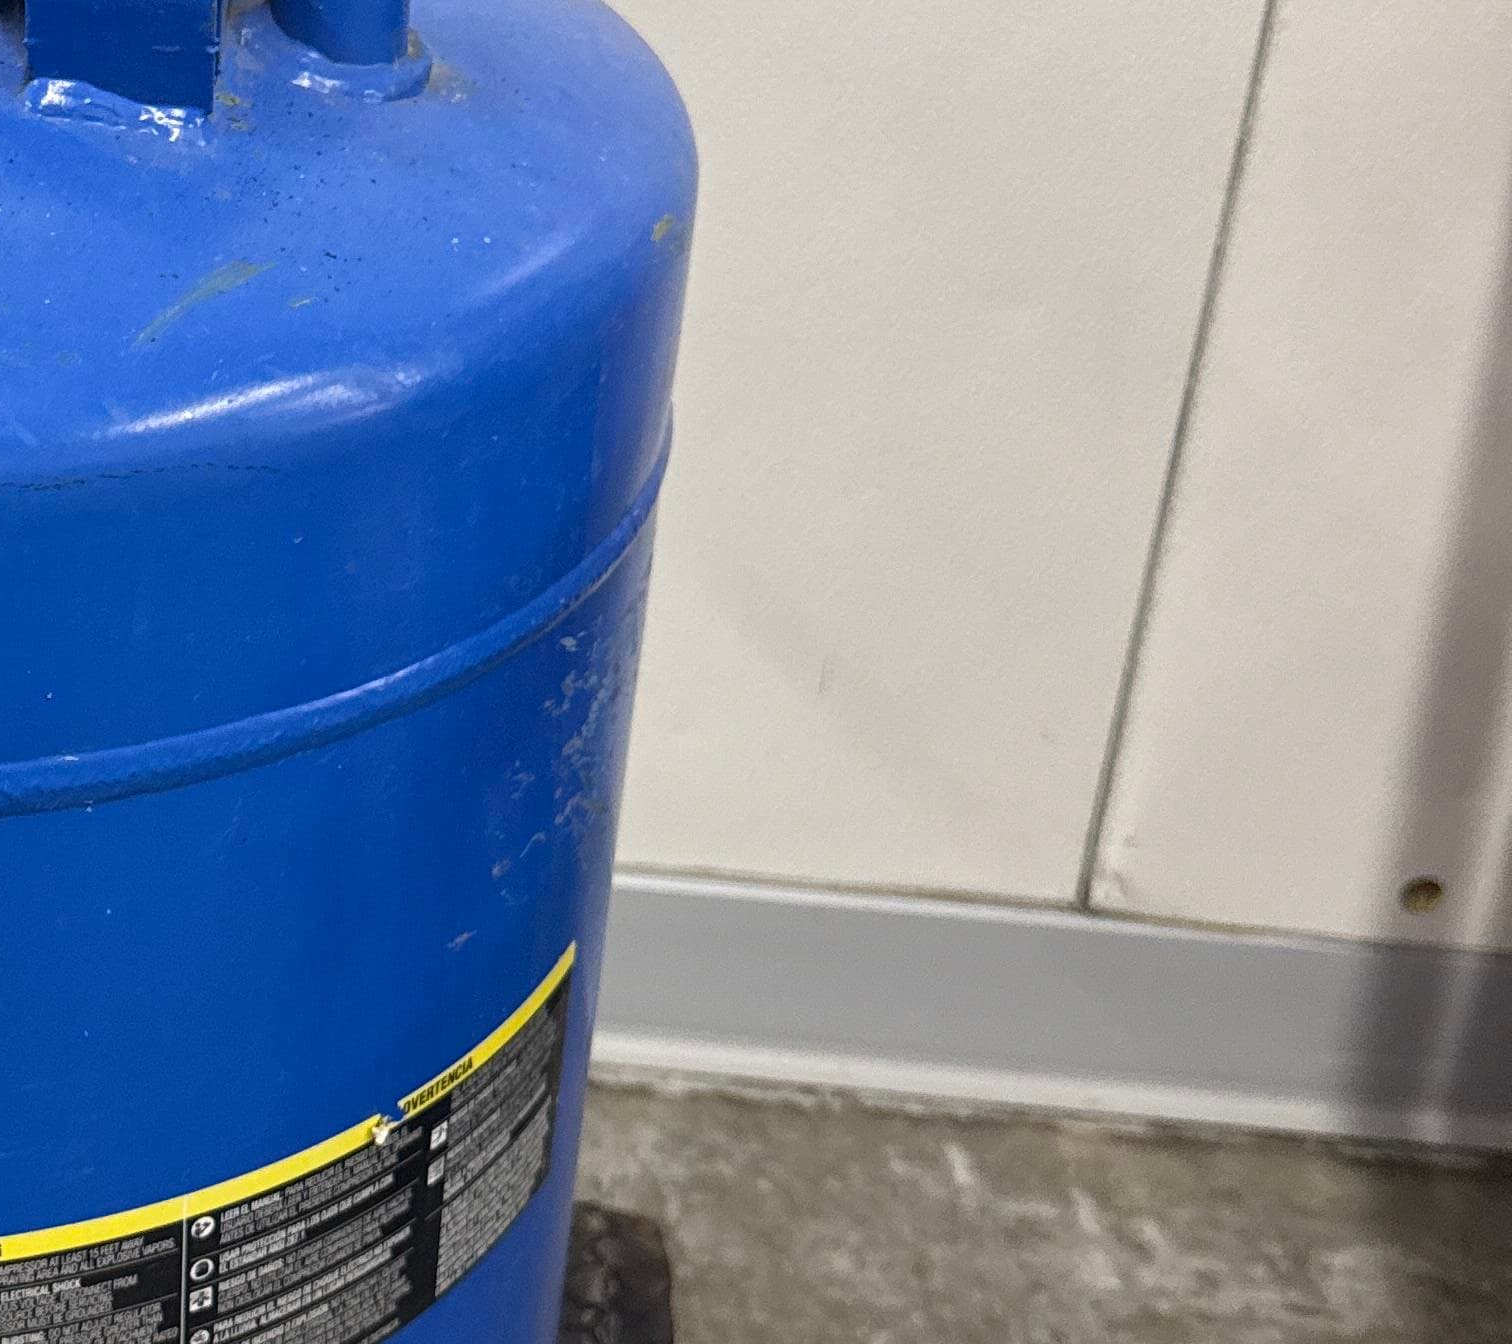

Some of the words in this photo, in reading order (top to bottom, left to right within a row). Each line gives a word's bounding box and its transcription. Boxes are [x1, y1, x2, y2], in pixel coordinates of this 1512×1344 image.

[49, 1256, 60, 1267] AT
[61, 1250, 88, 1265] LEAST
[89, 1248, 99, 1259] 15
[100, 1243, 119, 1256] FEET
[119, 1237, 144, 1252] AWAY
[0, 1285, 50, 1301] ELECTRICAL
[52, 1278, 81, 1292] SHOCK
